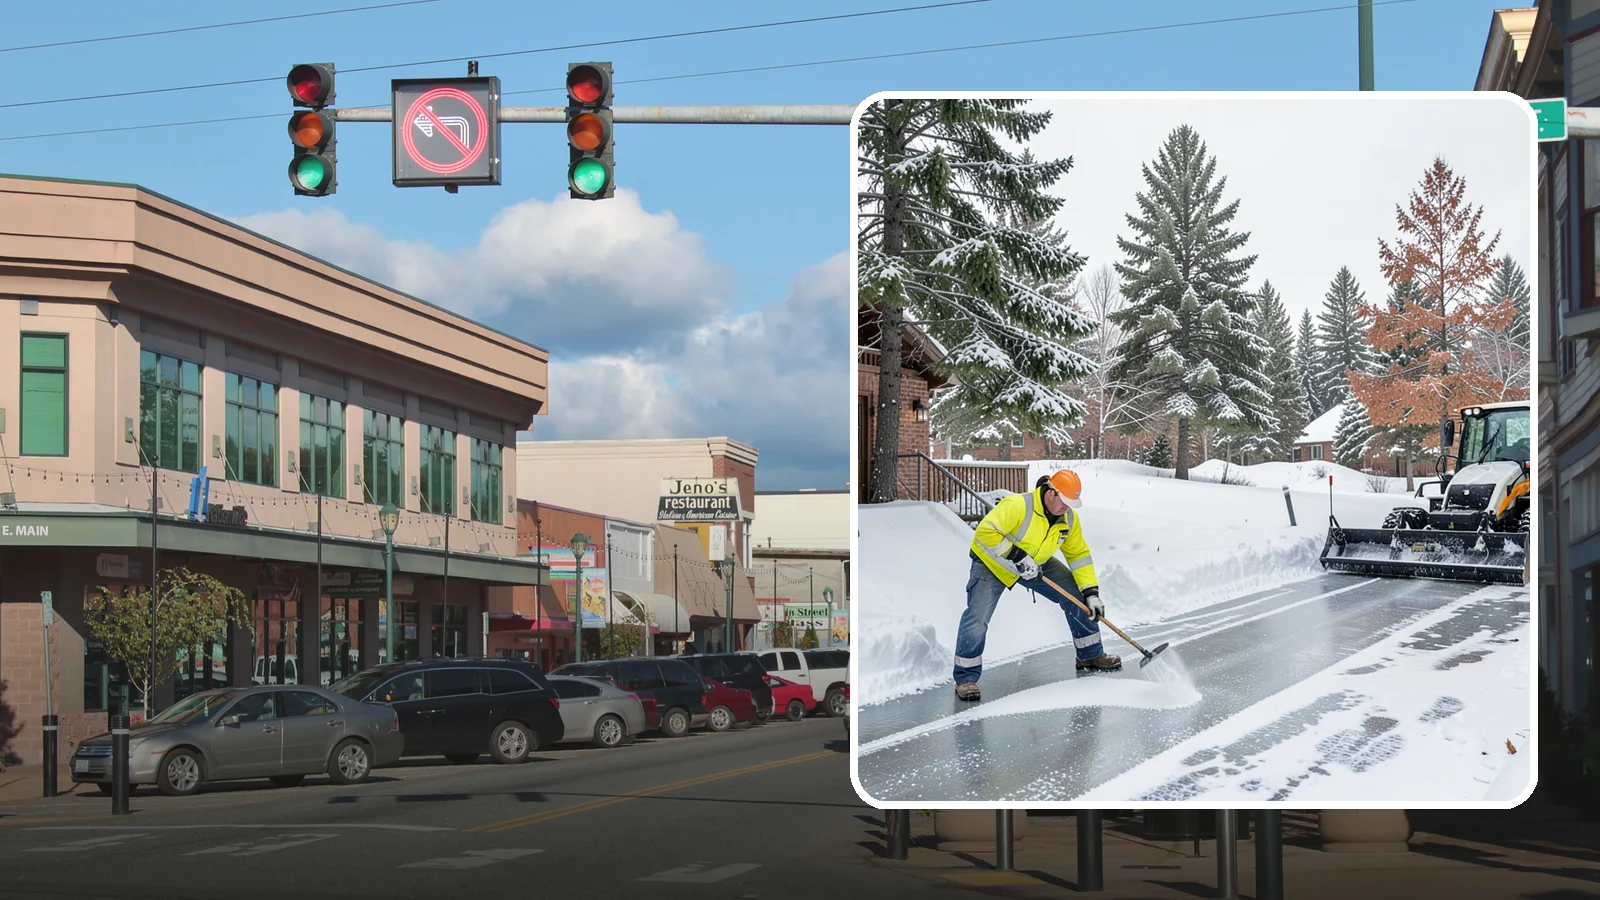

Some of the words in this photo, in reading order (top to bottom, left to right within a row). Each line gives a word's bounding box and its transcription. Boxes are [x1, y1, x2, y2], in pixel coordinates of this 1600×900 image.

[670, 480, 727, 494] Jeno's
[664, 496, 731, 509] restaurant
[658, 510, 682, 520] Italian
[686, 510, 714, 519] American
[715, 510, 738, 519] Cuisine
[2, 525, 13, 536] E.
[15, 525, 49, 536] MAIN
[797, 608, 829, 616] Street
